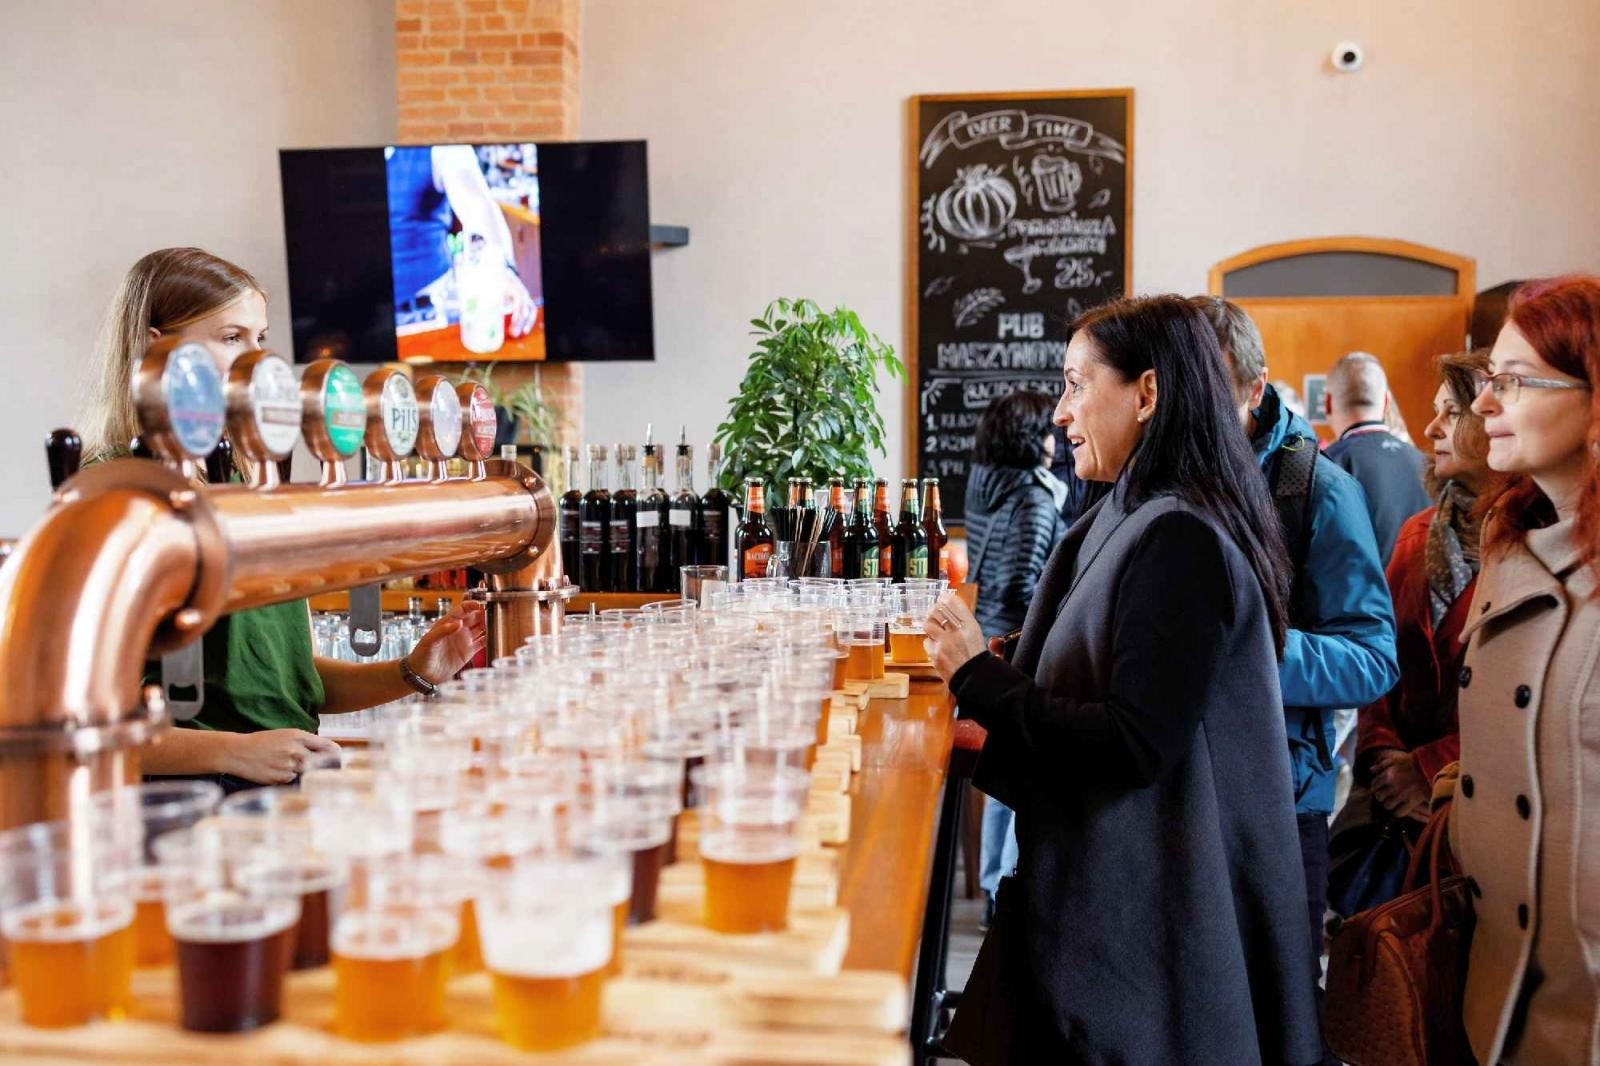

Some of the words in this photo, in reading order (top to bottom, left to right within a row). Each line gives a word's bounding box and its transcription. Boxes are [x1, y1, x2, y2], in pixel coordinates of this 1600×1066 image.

[1034, 121, 1080, 137] TIME
[997, 312, 1045, 339] PUB
[937, 341, 1067, 368] MASZYNOW
